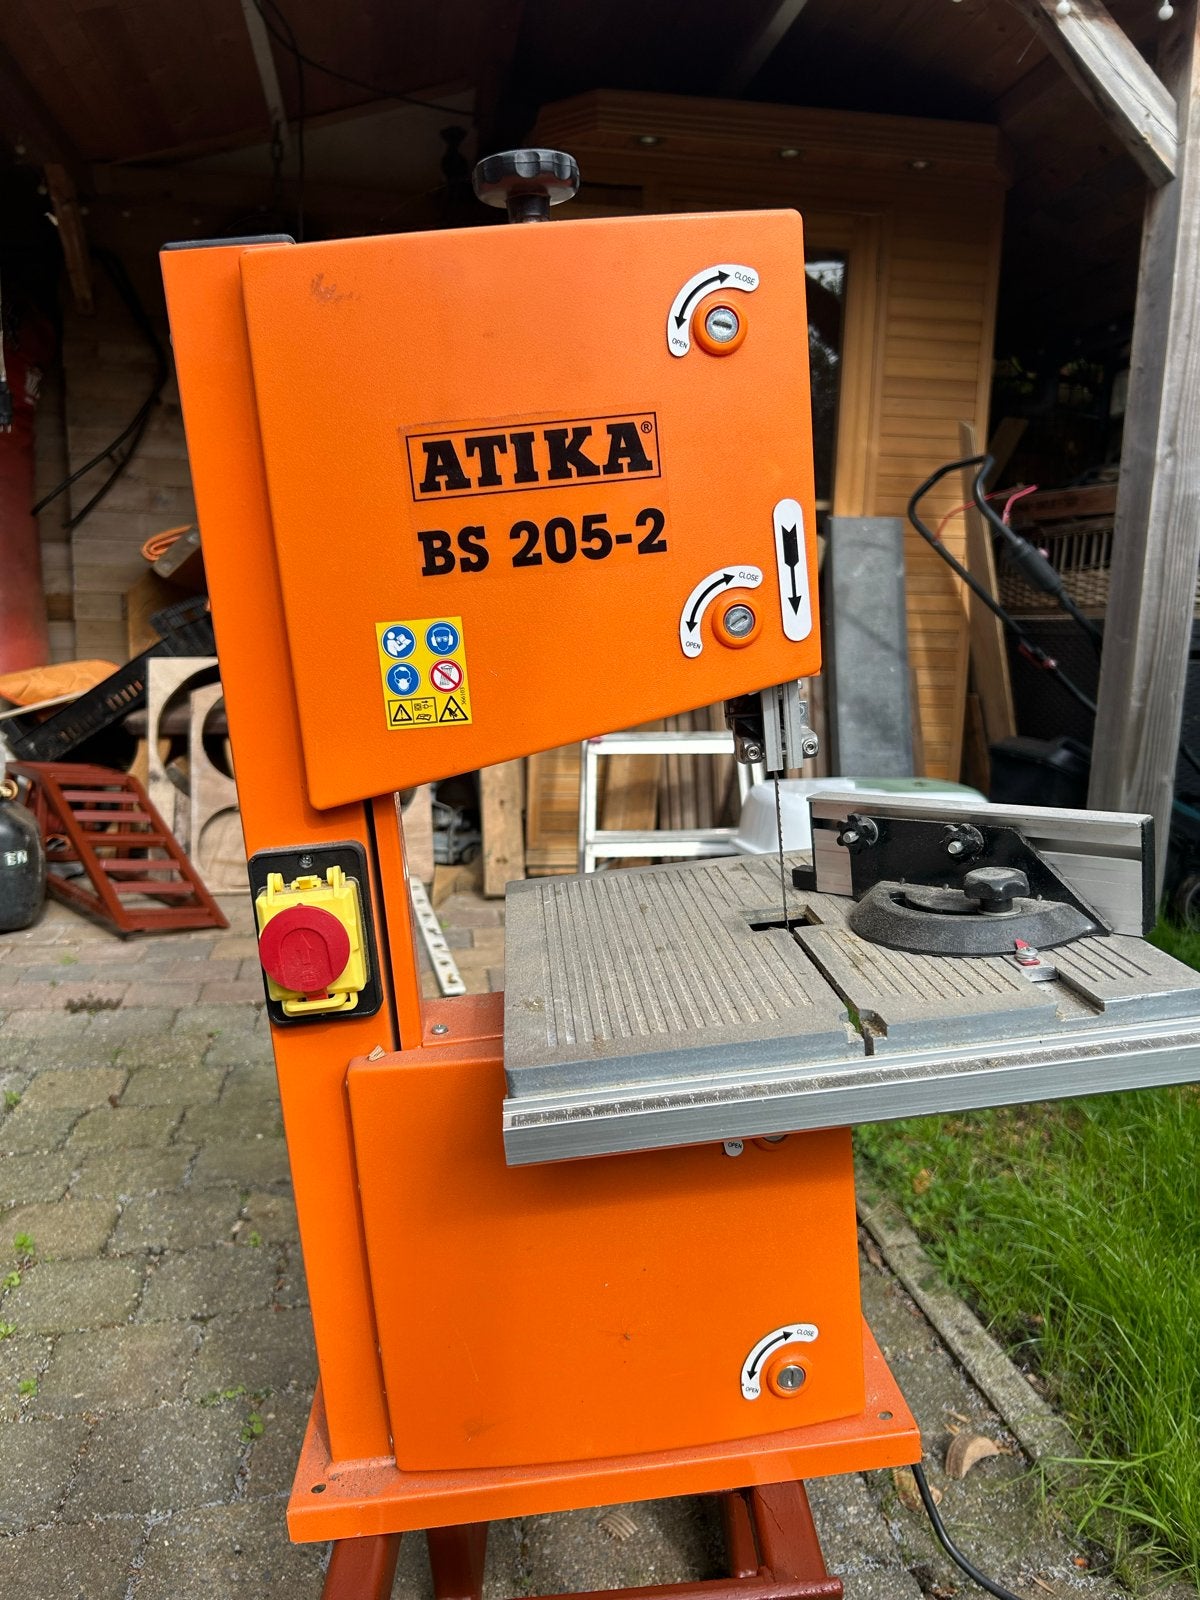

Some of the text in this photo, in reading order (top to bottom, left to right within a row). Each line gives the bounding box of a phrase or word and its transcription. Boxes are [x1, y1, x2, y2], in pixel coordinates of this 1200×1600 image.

[734, 271, 755, 285] CLOSE
[671, 338, 688, 349] OPEN
[418, 507, 668, 577] BS 205-2
[738, 571, 759, 582] CLOSE
[685, 641, 700, 649] OPEN
[728, 1141, 742, 1149] OPEN
[796, 1328, 815, 1337] CLOSE
